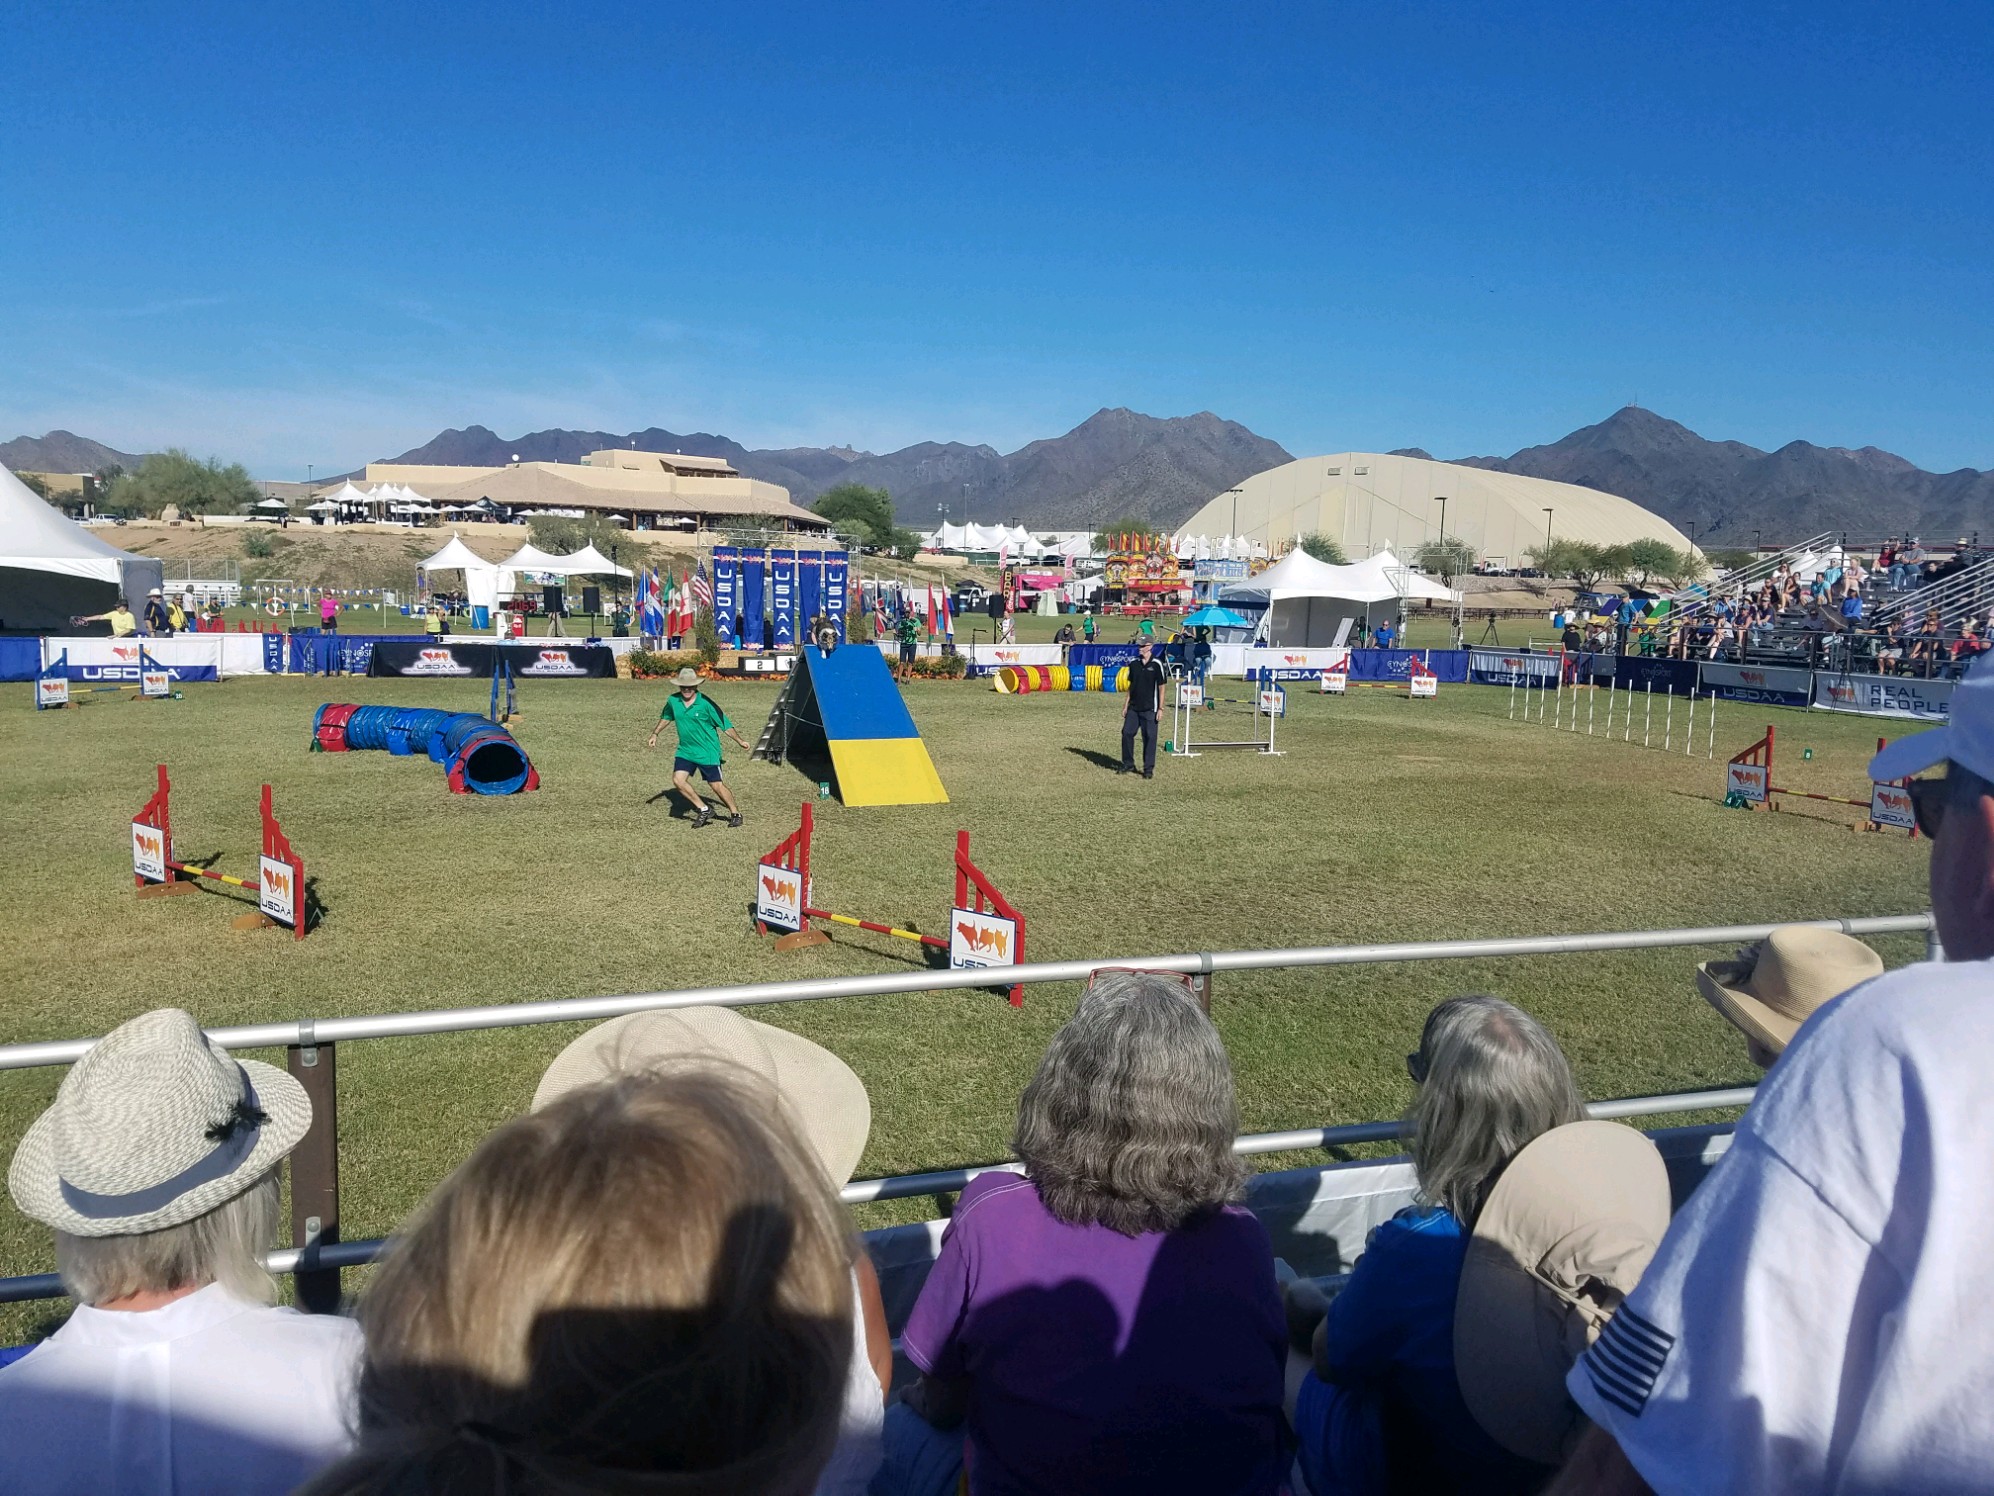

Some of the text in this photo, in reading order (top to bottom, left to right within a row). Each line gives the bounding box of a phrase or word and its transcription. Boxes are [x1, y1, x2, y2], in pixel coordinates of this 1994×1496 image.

[717, 568, 732, 635] USDAA
[775, 570, 790, 636] USDAA
[268, 636, 278, 671] USDAA
[82, 667, 180, 680] USDA
[975, 666, 1001, 676] US
[1723, 687, 1785, 703] USDAA
[1870, 685, 1922, 698] REAL
[1870, 697, 1949, 714] PEOPLE
[1872, 812, 1914, 825] USDAA
[135, 861, 164, 877] USDAA
[261, 898, 293, 918] USDAA
[758, 905, 798, 925] USDAA
[952, 956, 989, 969] USD
